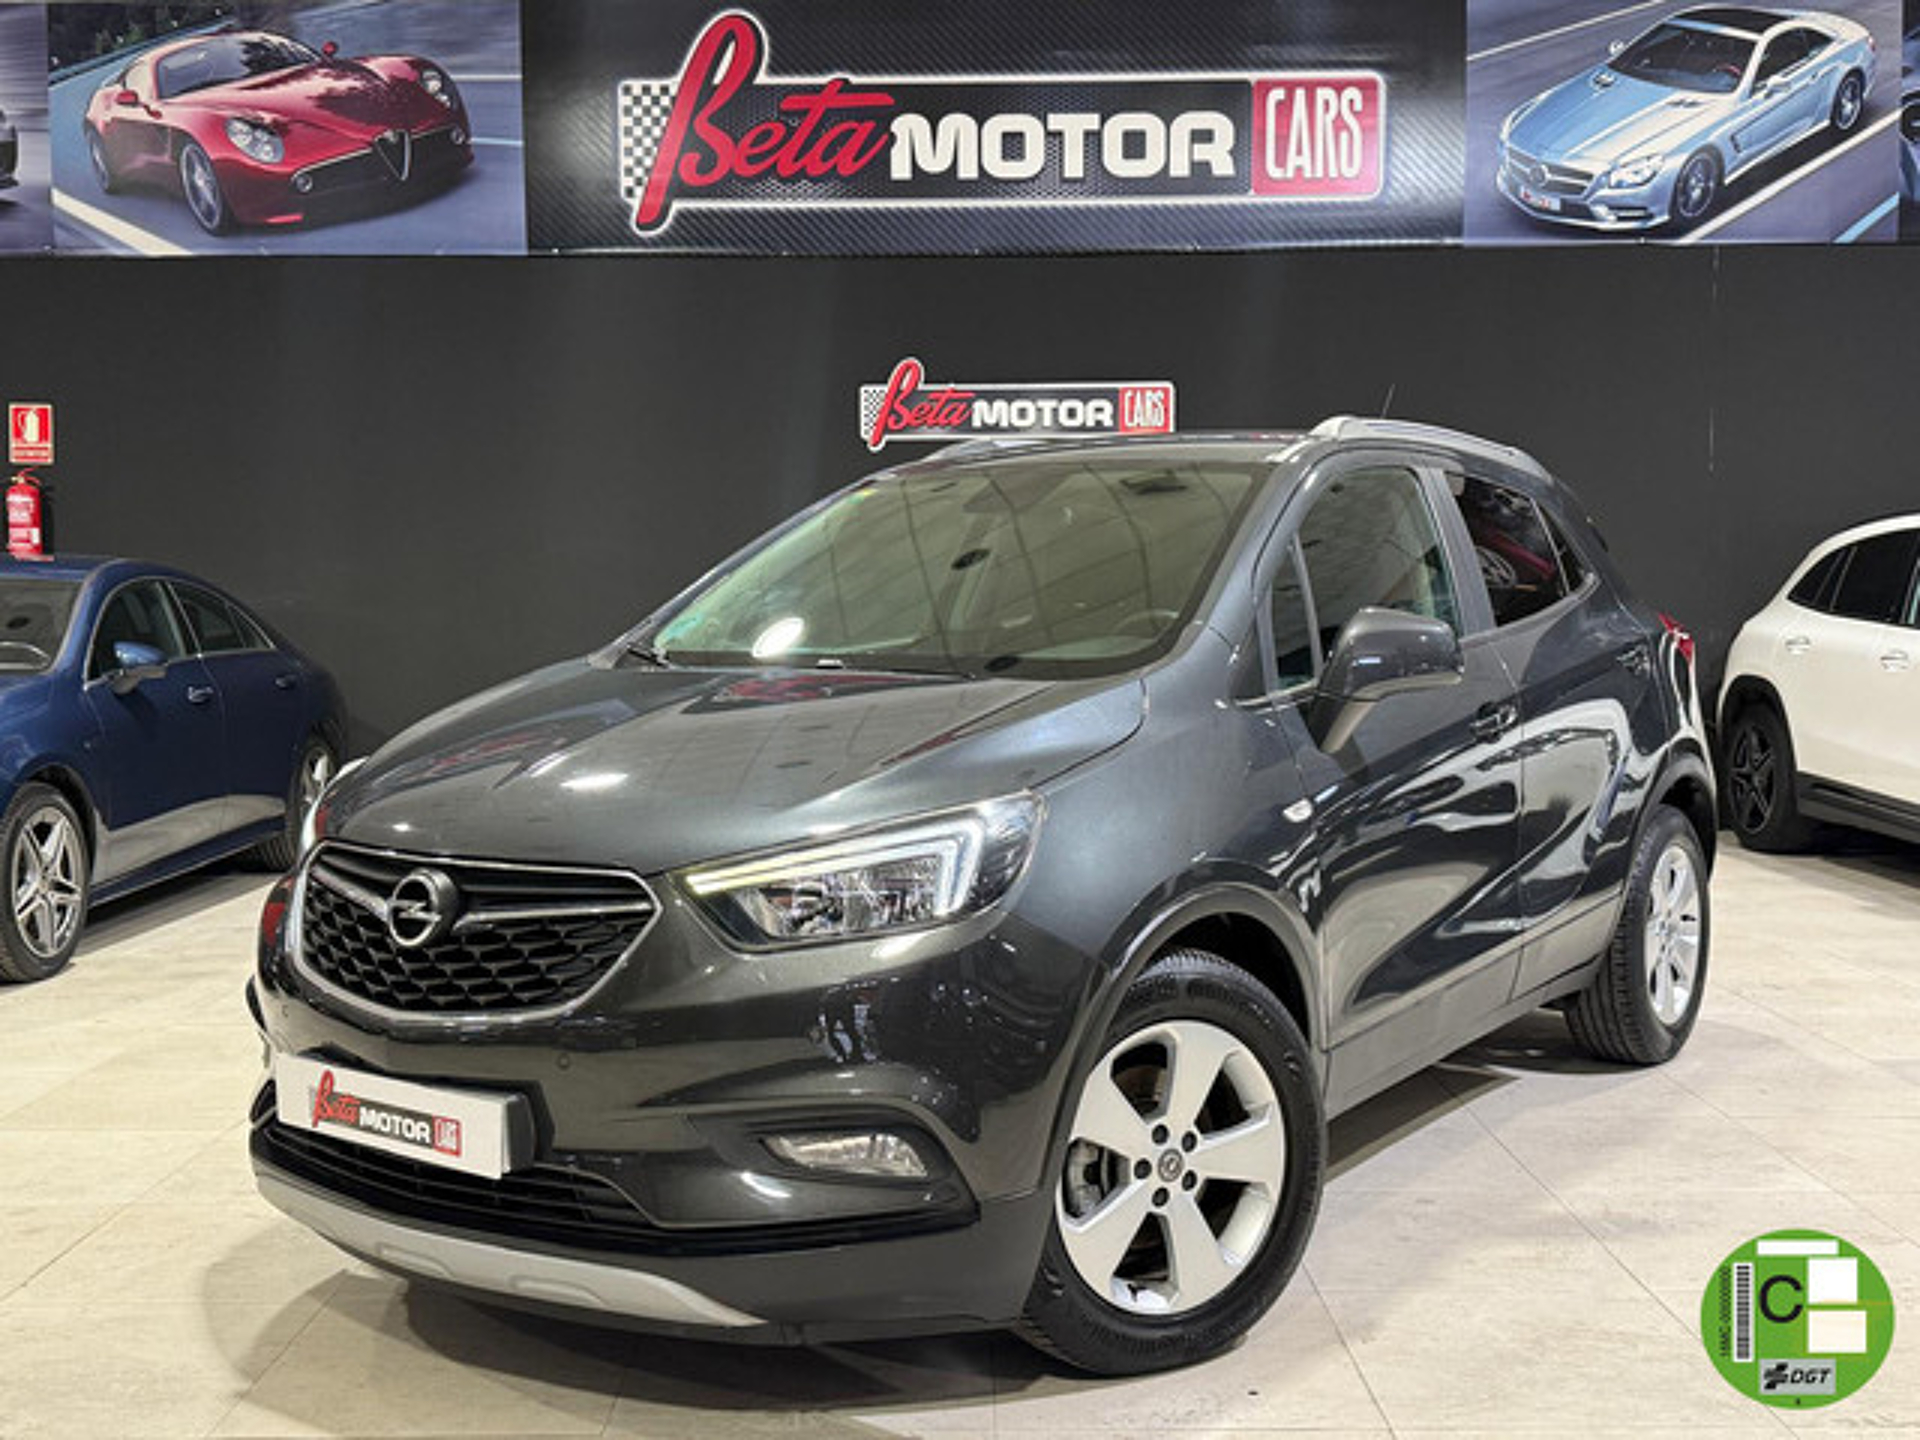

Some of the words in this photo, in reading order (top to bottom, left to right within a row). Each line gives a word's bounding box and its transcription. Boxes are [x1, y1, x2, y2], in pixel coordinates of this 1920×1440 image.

[891, 110, 1236, 180] MOTOR
[1265, 88, 1363, 180] CARS
[971, 399, 1113, 427] MOTOR
[1124, 389, 1167, 428] CARS
[359, 1107, 432, 1144] MOTOR
